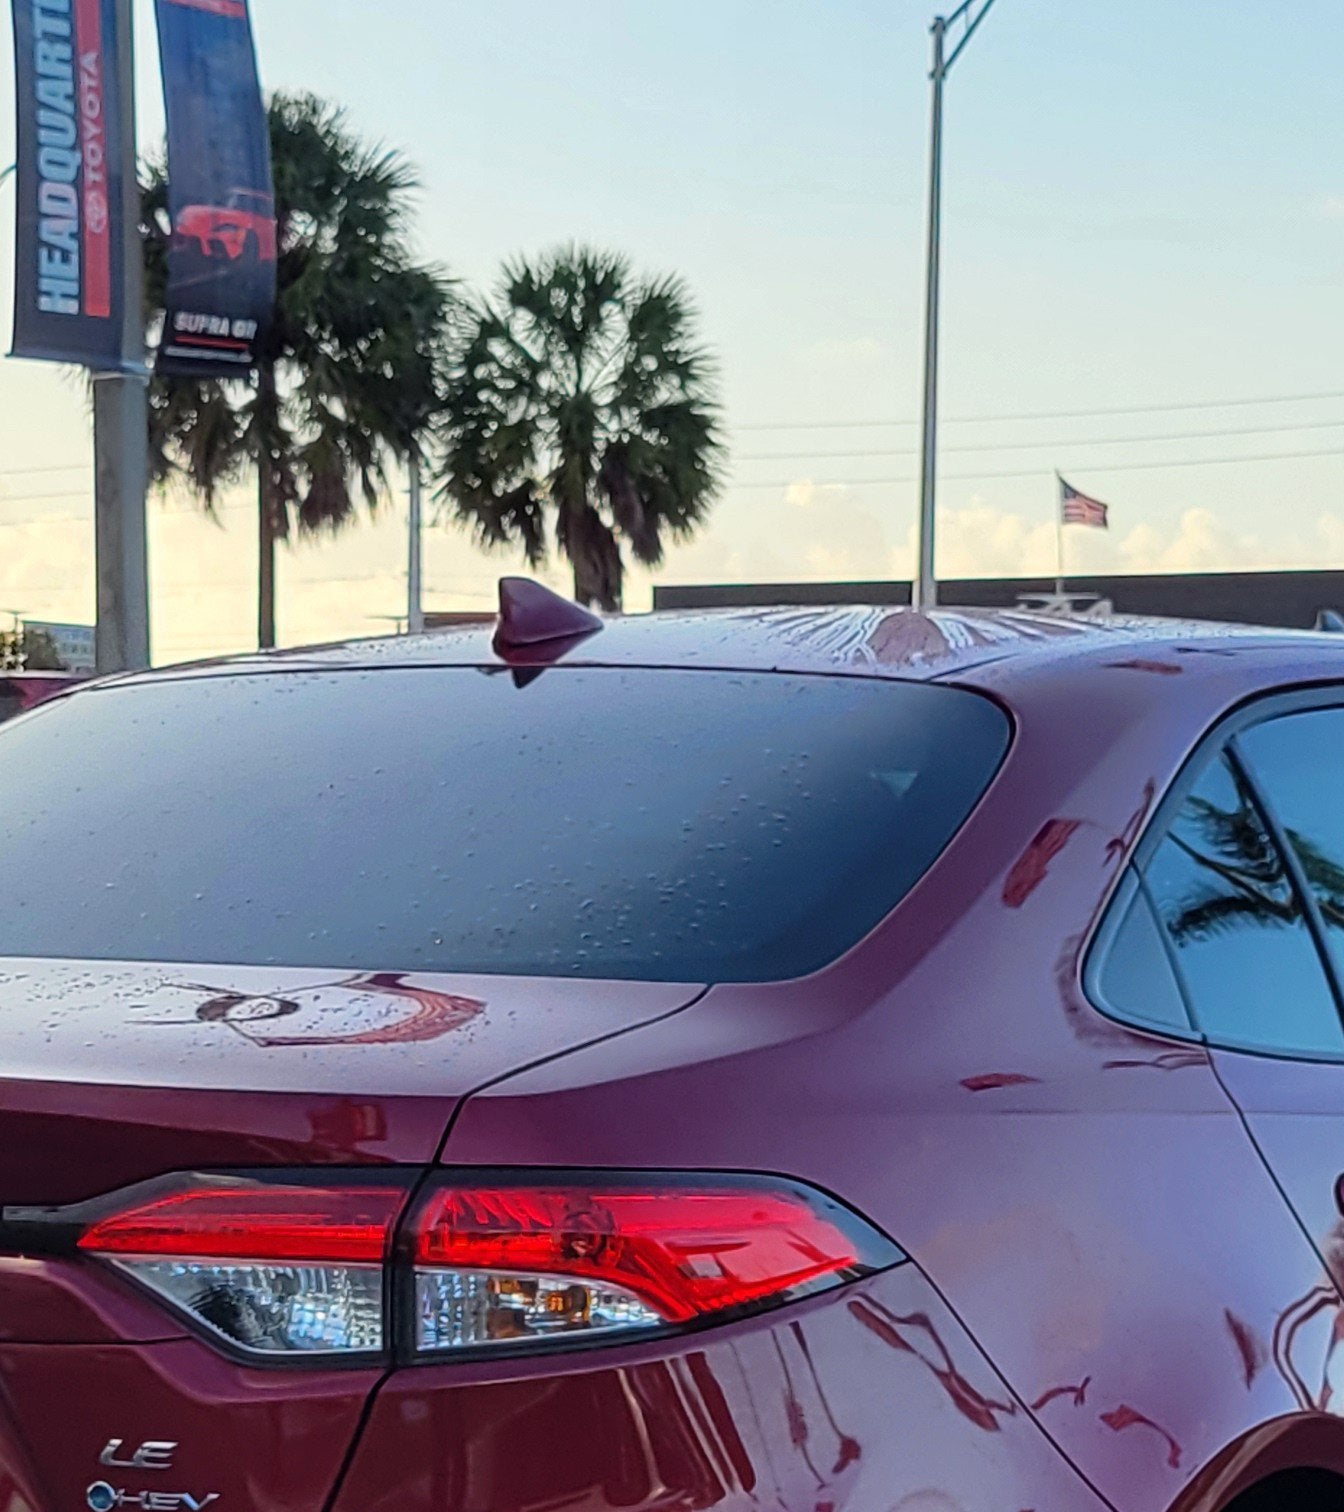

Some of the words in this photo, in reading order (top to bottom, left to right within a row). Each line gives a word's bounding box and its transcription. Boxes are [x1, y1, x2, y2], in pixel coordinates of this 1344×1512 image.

[79, 51, 105, 182] TOYOTA
[175, 311, 229, 337] SUPRA
[99, 1438, 178, 1469] LE
